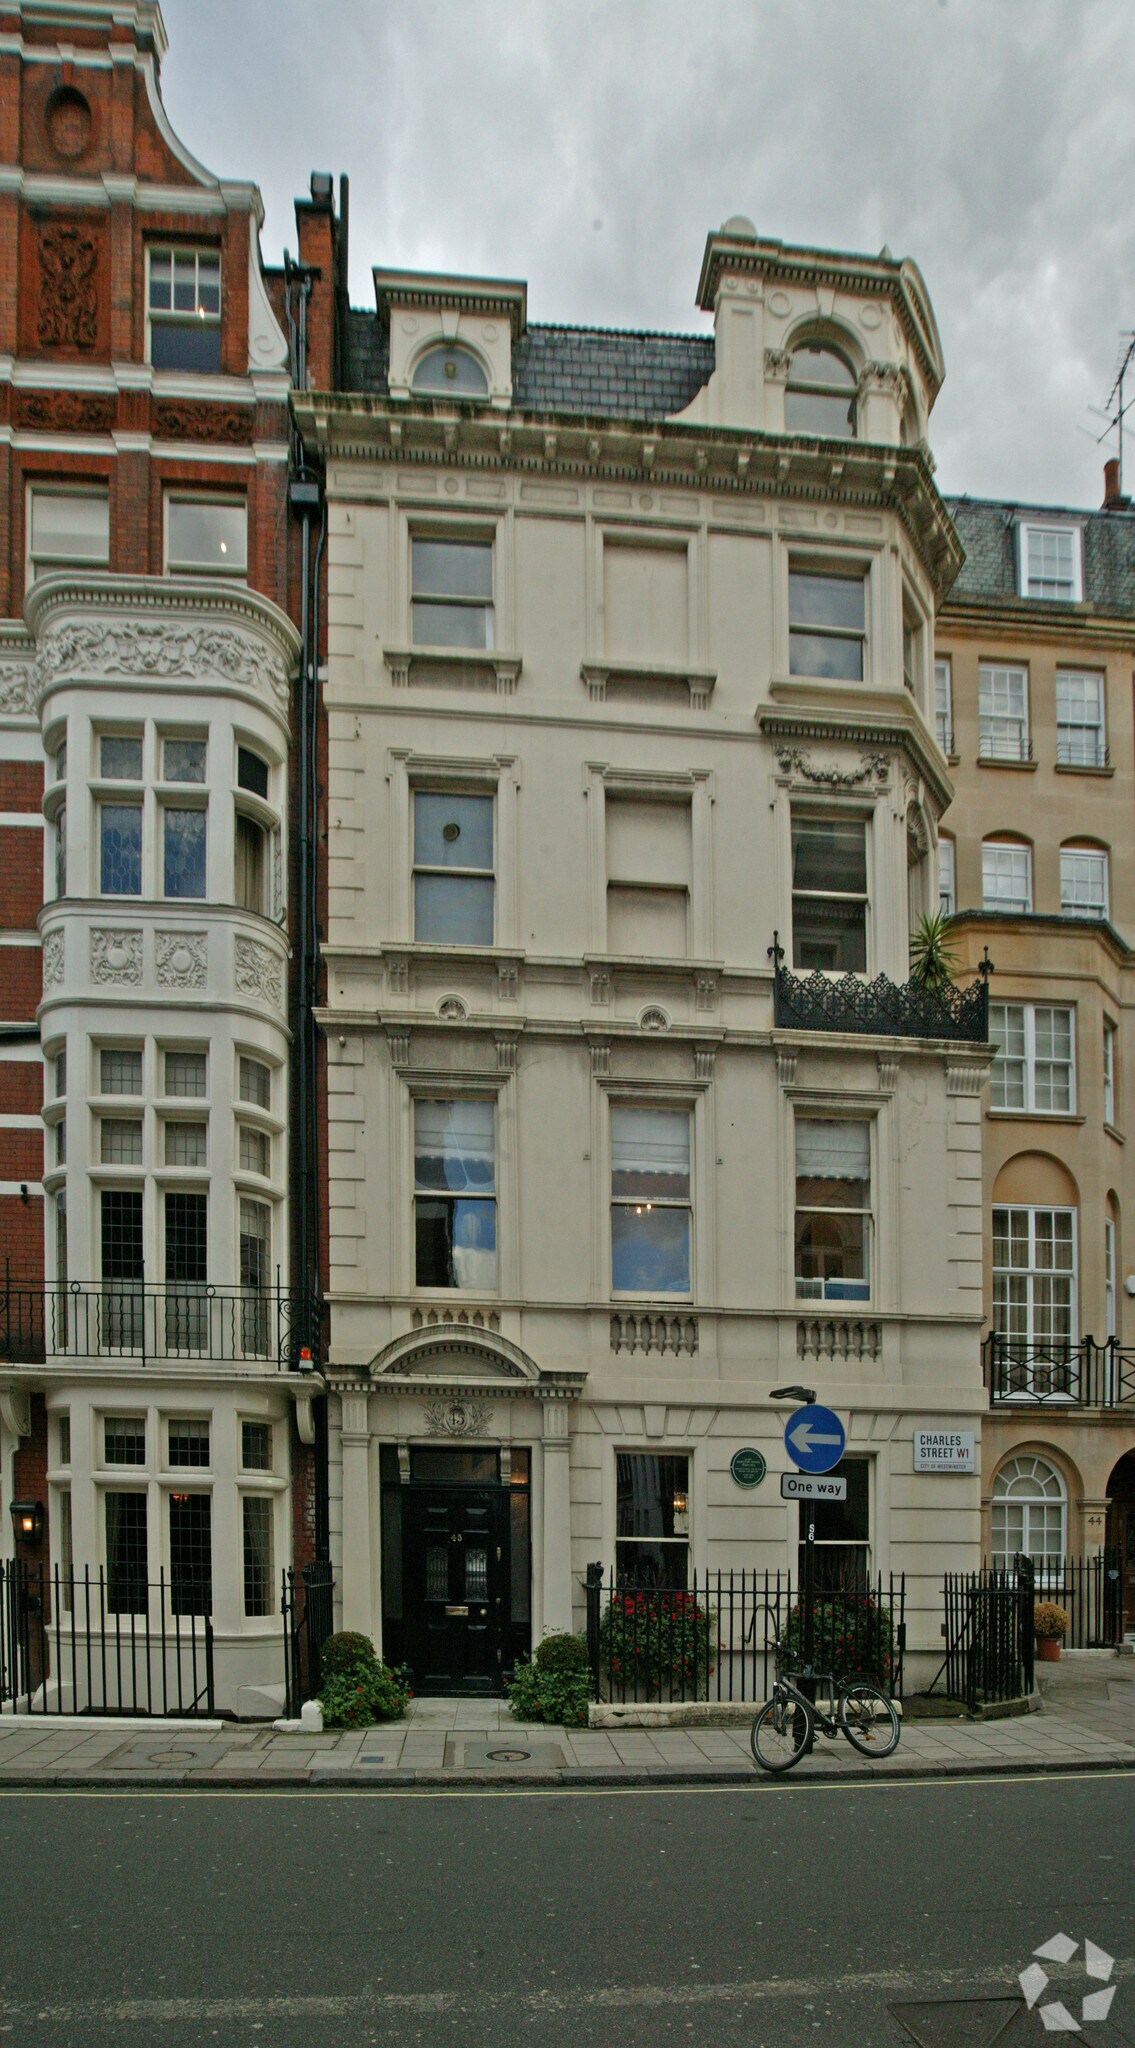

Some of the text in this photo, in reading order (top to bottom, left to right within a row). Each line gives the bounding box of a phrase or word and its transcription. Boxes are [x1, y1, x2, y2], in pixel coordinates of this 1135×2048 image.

[920, 1434, 962, 1446] CHARLES
[920, 1447, 969, 1459] STREET W1
[787, 1479, 842, 1496] One way
[1088, 1516, 1102, 1525] 44
